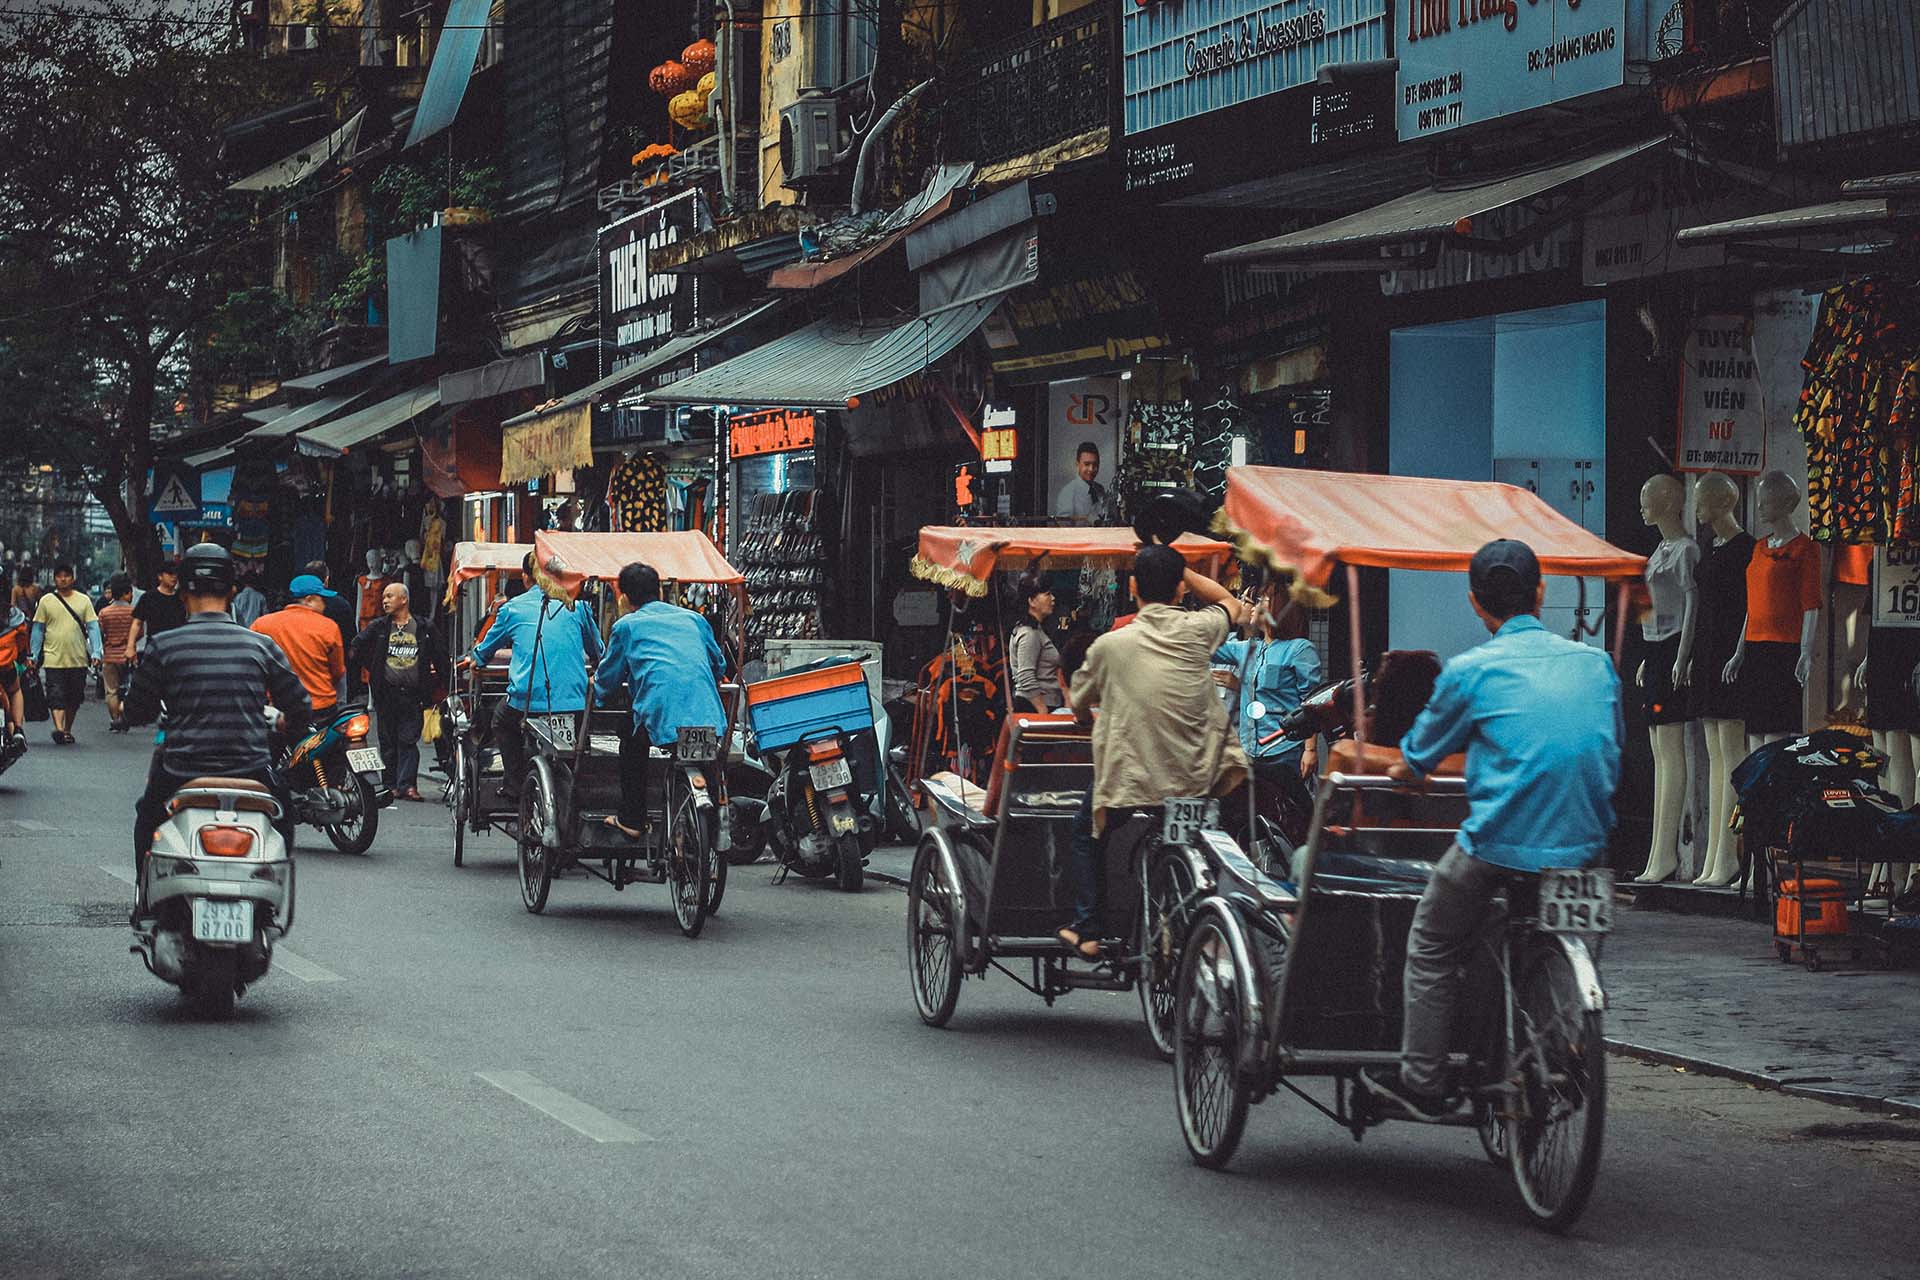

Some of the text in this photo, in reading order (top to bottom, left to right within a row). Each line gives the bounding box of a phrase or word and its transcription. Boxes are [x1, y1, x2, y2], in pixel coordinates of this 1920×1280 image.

[1184, 8, 1325, 76] Cosmetic & Accessories
[1555, 35, 1582, 64] HÀNG
[1582, 27, 1616, 55] NGANG
[609, 230, 647, 314] THIÊN
[1698, 356, 1753, 379] NHÂN
[1703, 387, 1745, 409] VIÊN
[1709, 420, 1735, 441] NỮ
[202, 920, 243, 938] 8700
